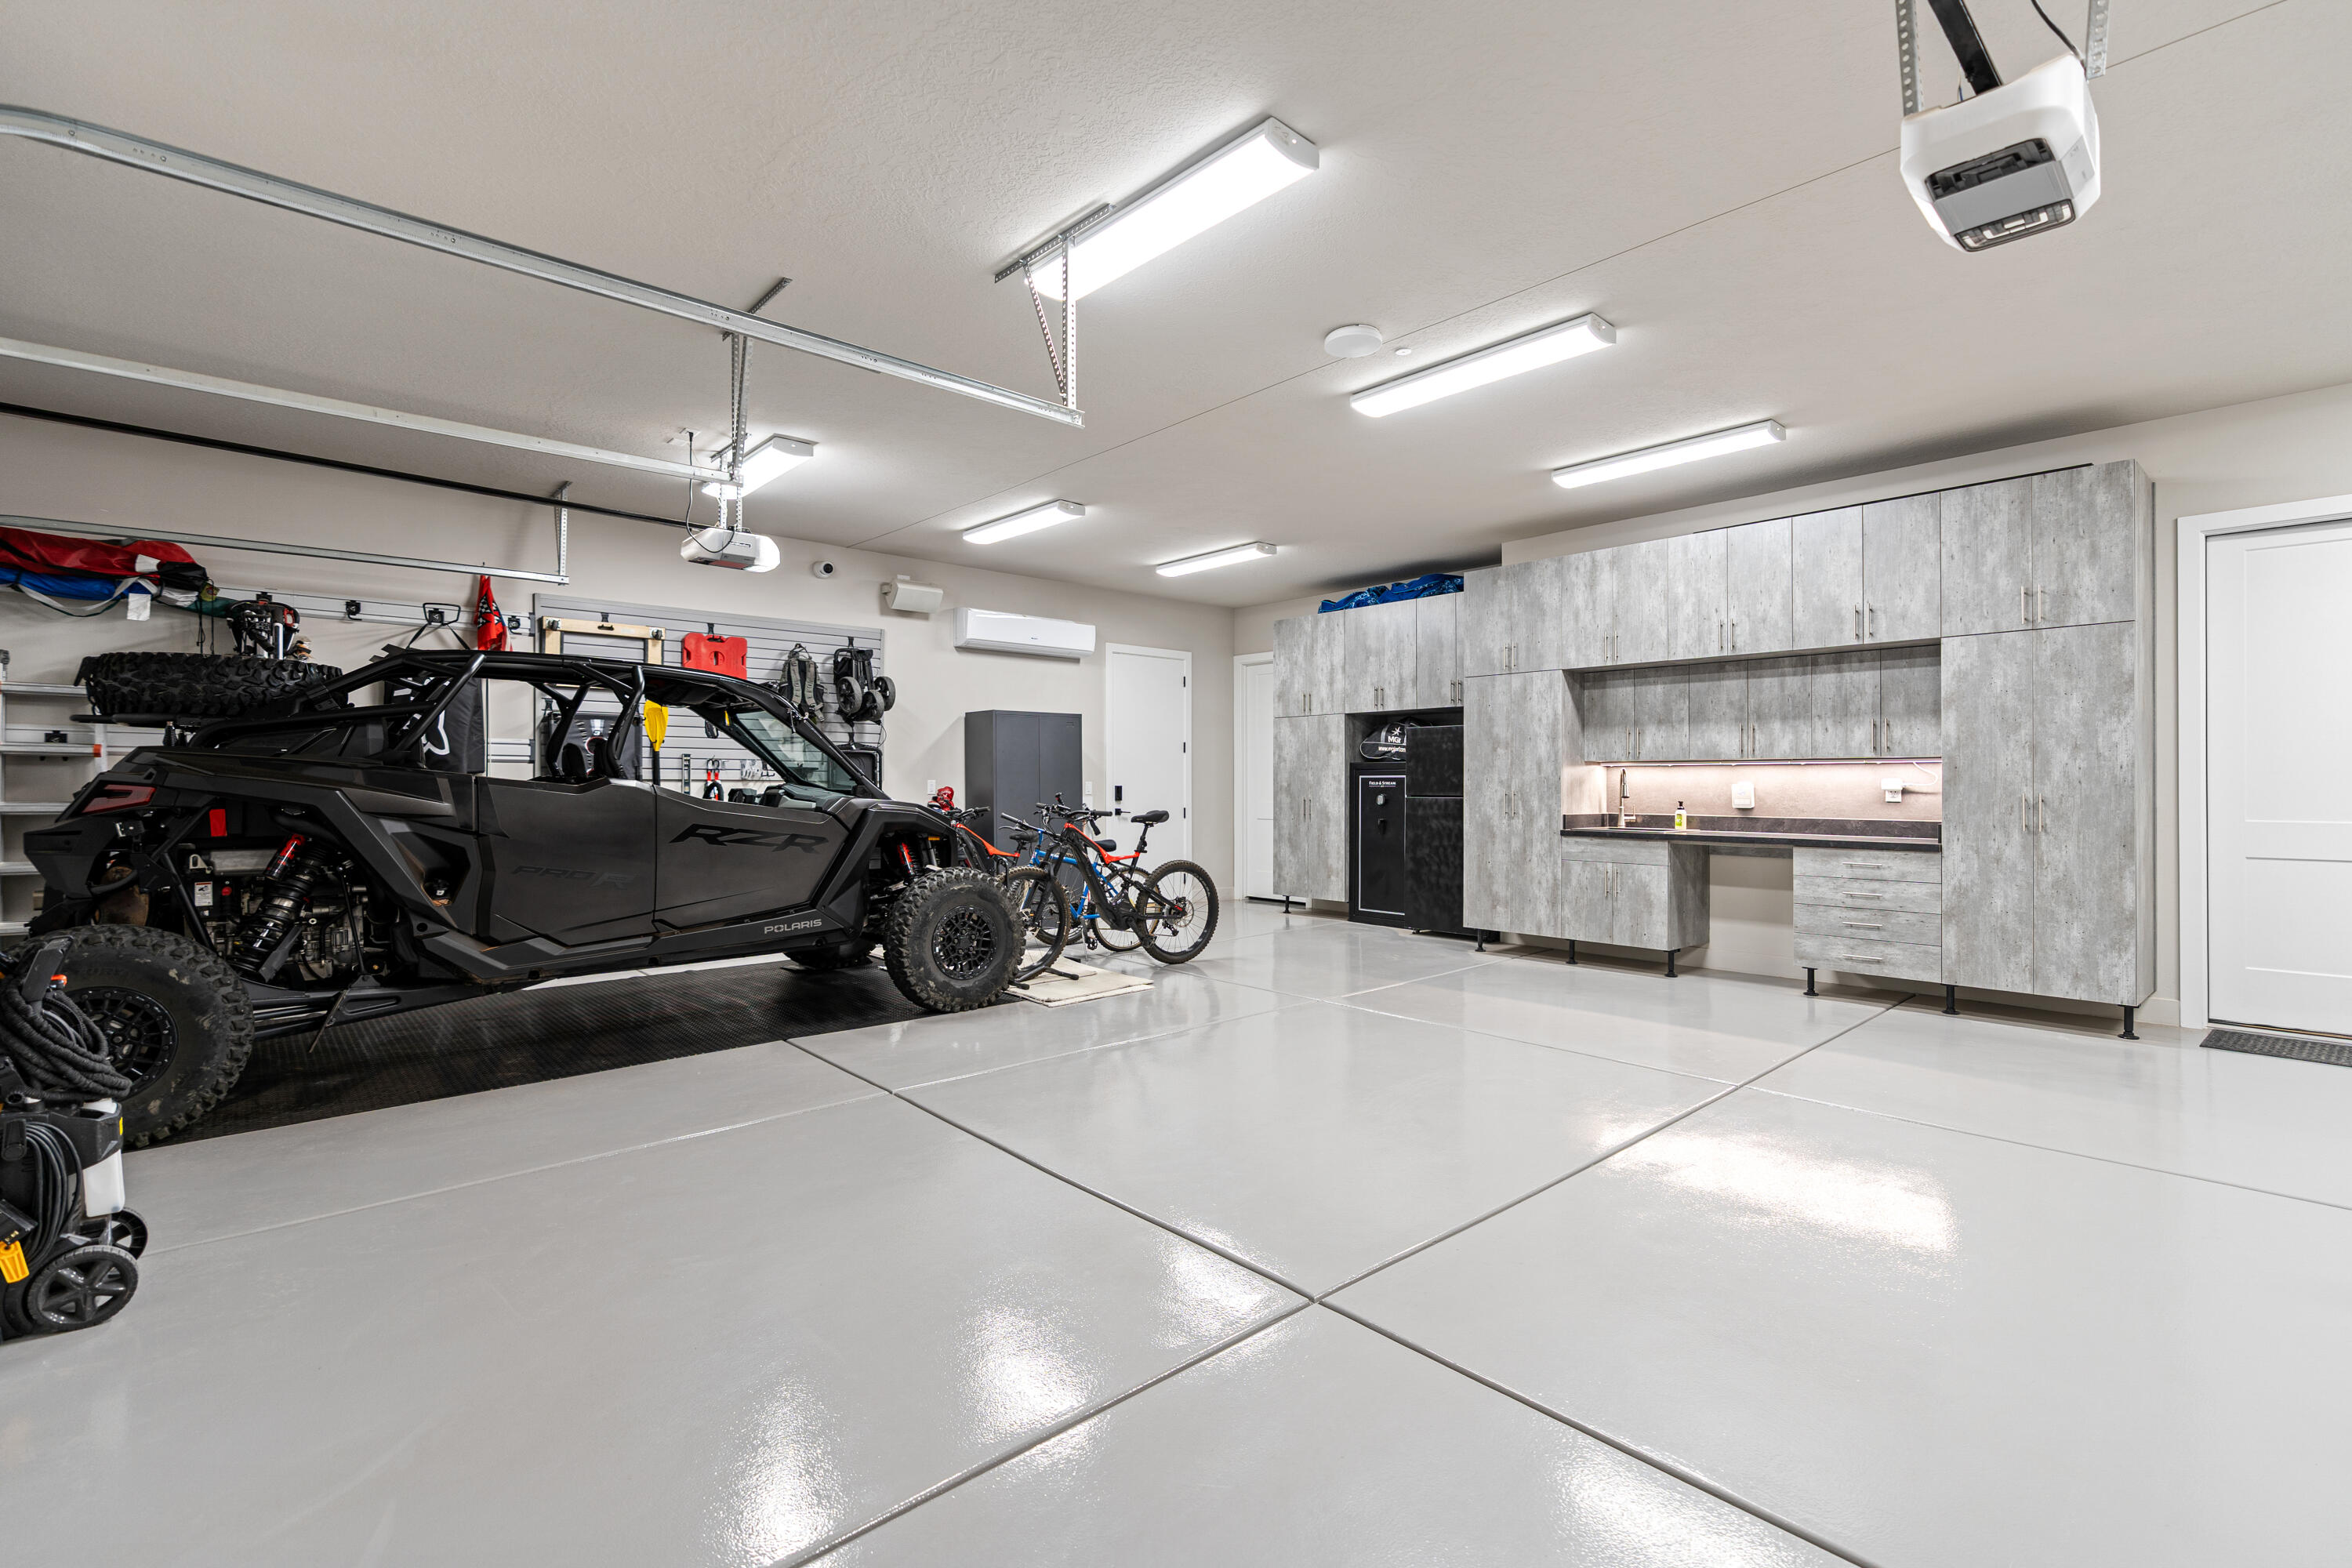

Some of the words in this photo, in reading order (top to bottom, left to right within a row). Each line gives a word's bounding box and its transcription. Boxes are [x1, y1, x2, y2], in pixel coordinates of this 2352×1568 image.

[669, 823, 829, 854] RZR
[511, 865, 597, 879] PRO
[764, 919, 822, 935] POLARIS
